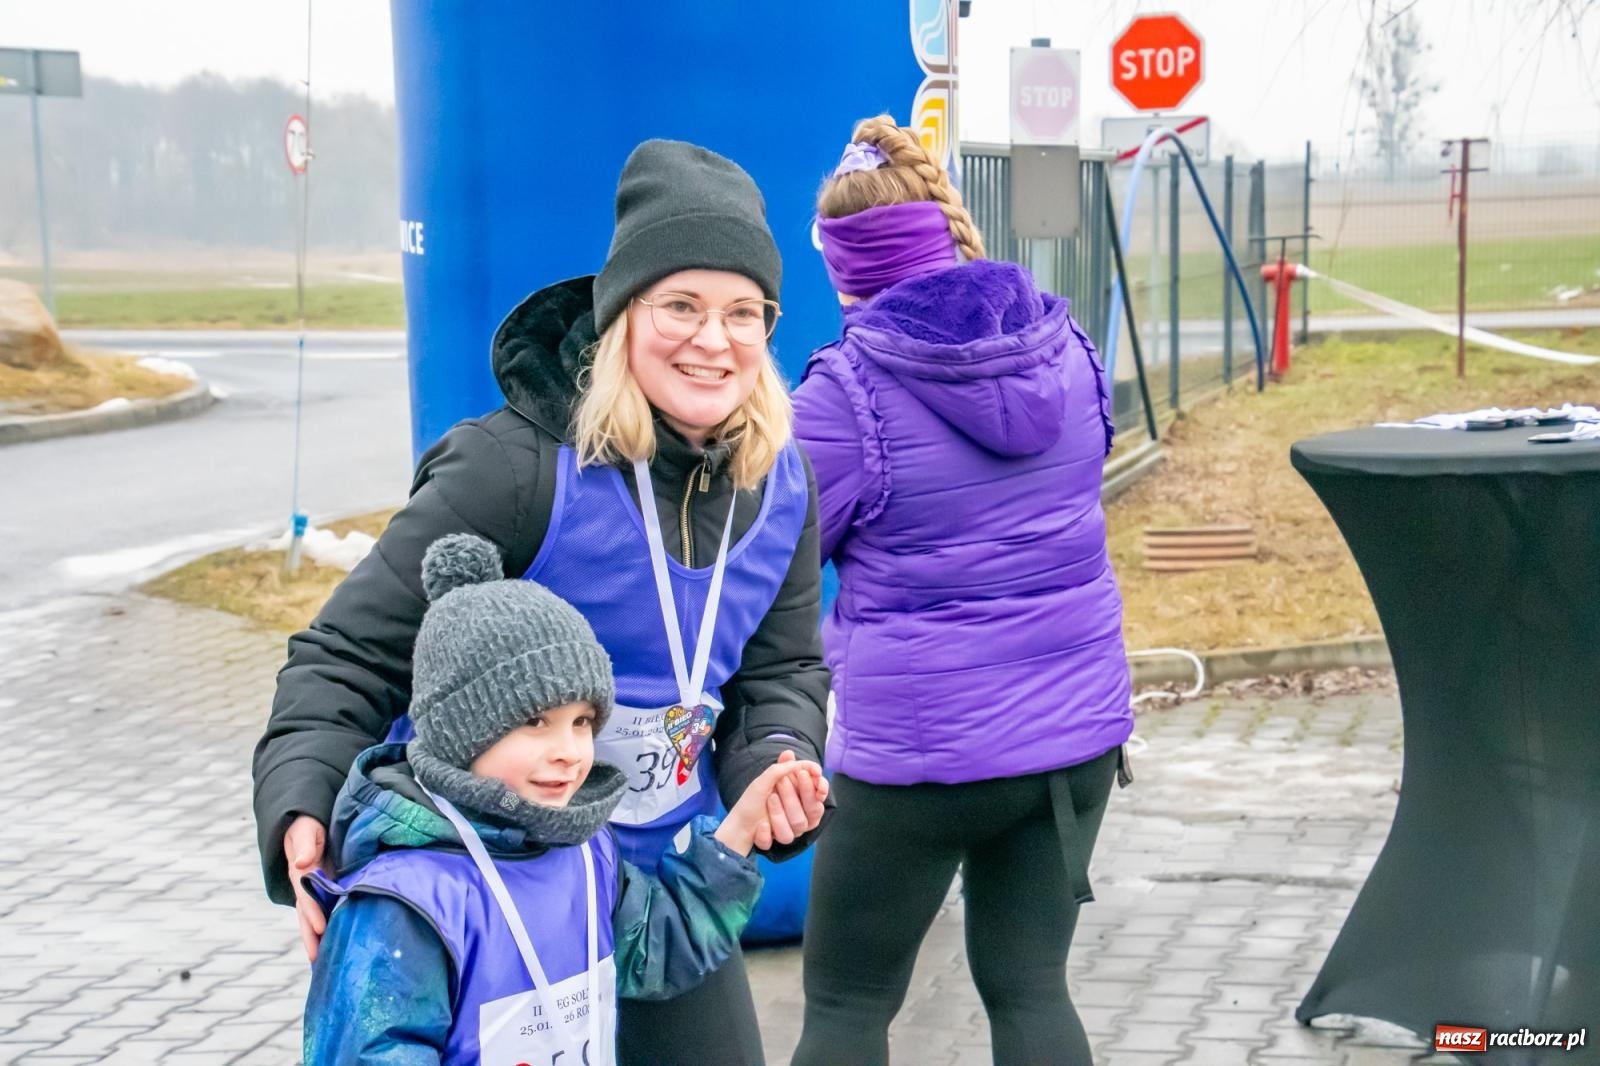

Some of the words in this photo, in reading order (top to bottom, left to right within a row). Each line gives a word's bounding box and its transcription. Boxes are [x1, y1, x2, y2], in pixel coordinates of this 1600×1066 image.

[1119, 46, 1196, 80] STOP
[1020, 85, 1073, 108] STOP
[615, 726, 665, 737] 25.01.202
[691, 719, 706, 734] 34
[628, 747, 678, 793] 39
[533, 1005, 542, 1016] II
